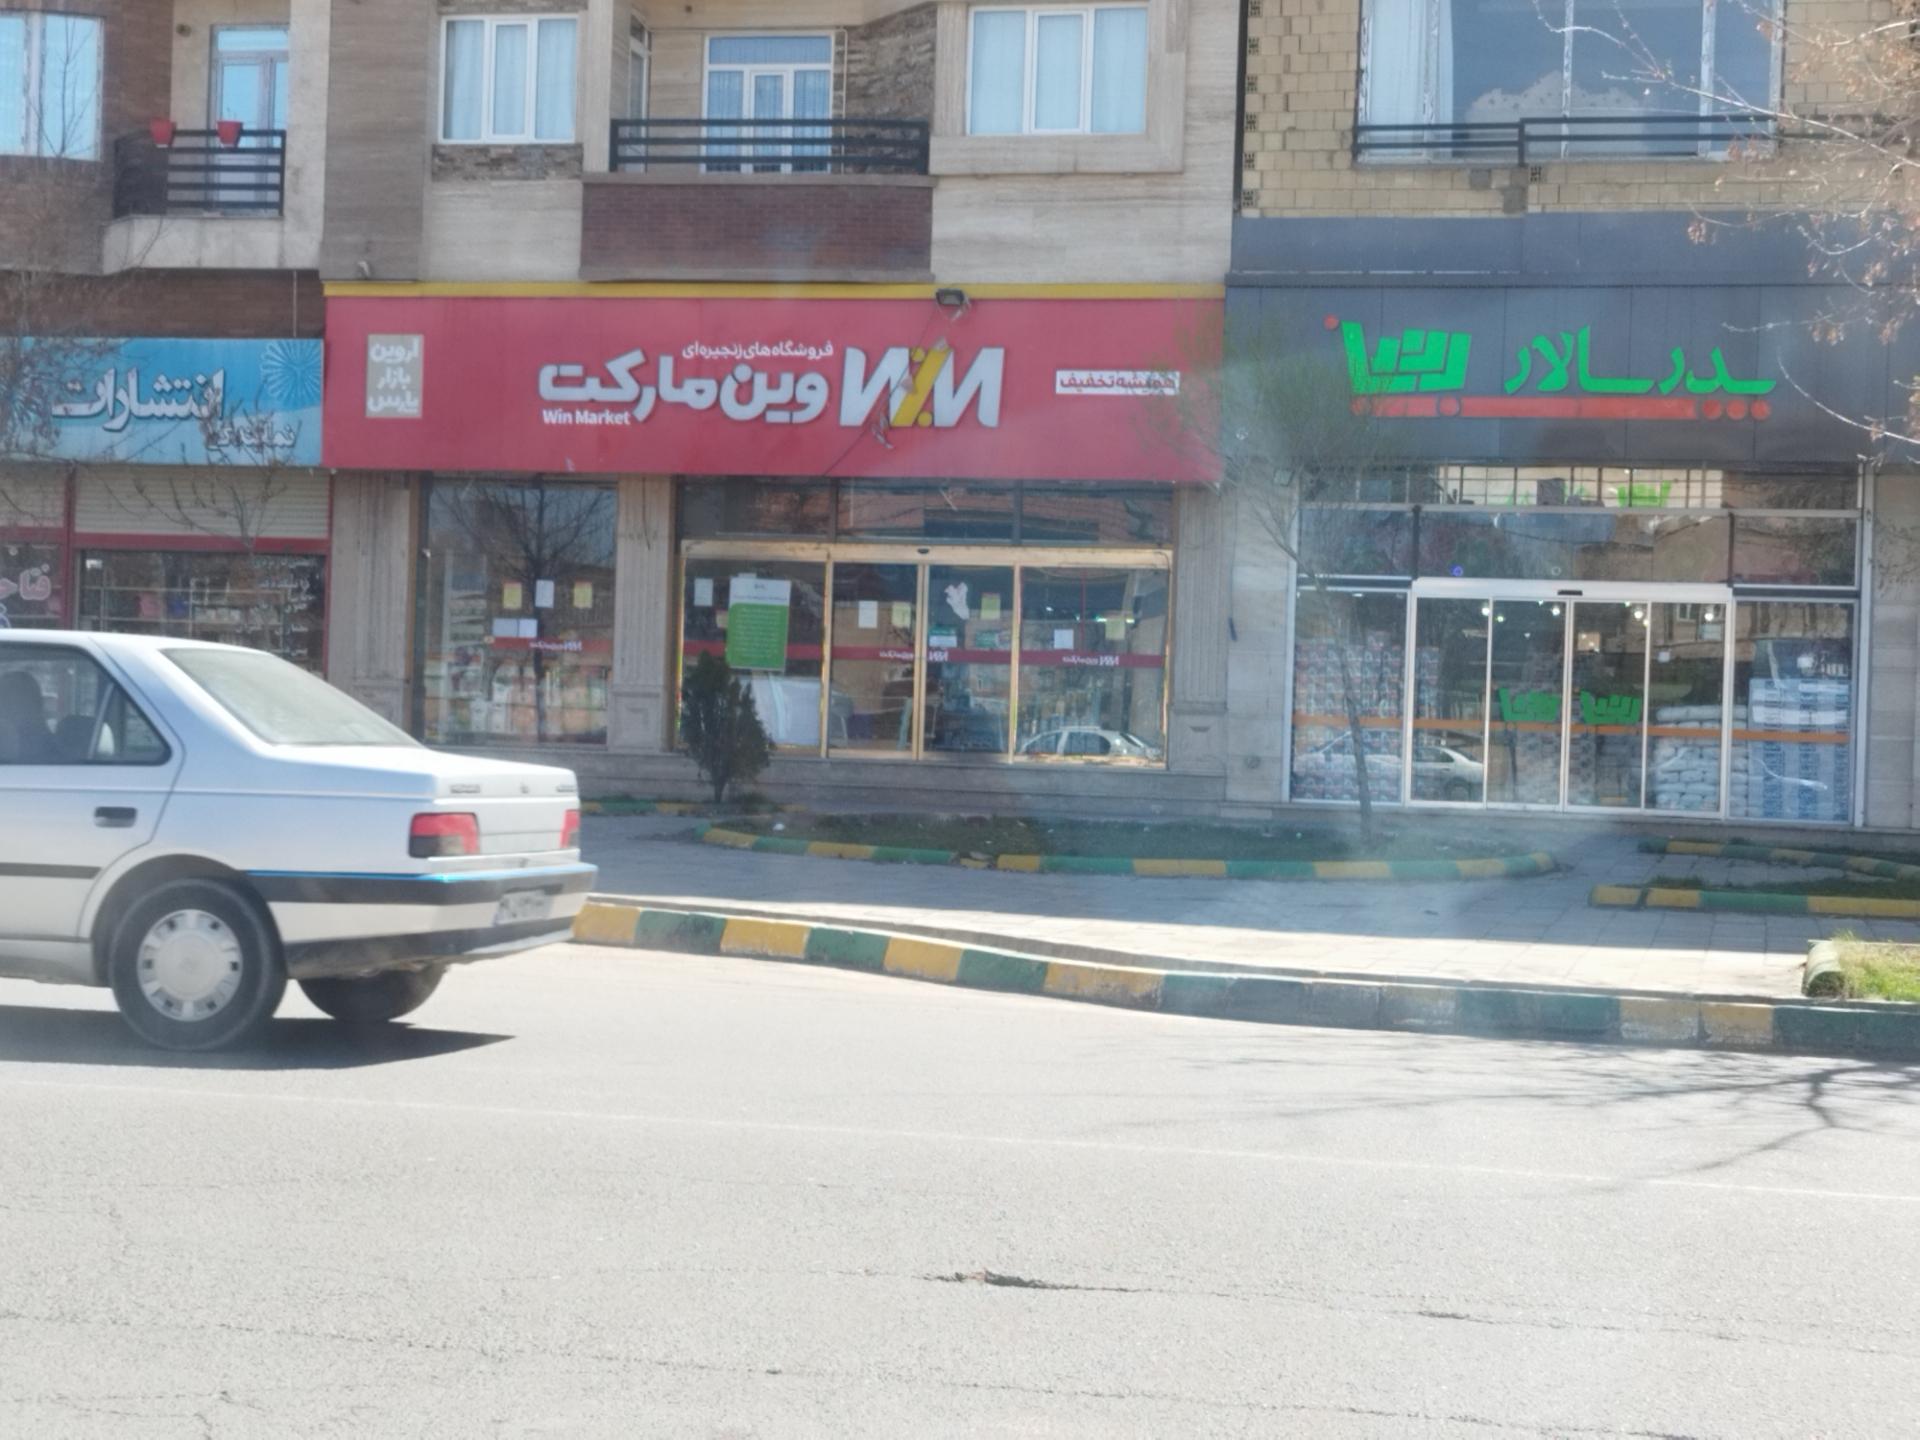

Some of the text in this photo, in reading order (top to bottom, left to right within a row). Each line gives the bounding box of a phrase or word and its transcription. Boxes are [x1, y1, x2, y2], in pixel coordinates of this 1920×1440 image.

[51, 366, 226, 432] انتشارات
[538, 349, 830, 423] وین مارکت
[1060, 371, 1115, 392] تخفیف
[542, 408, 631, 424] Win Market
